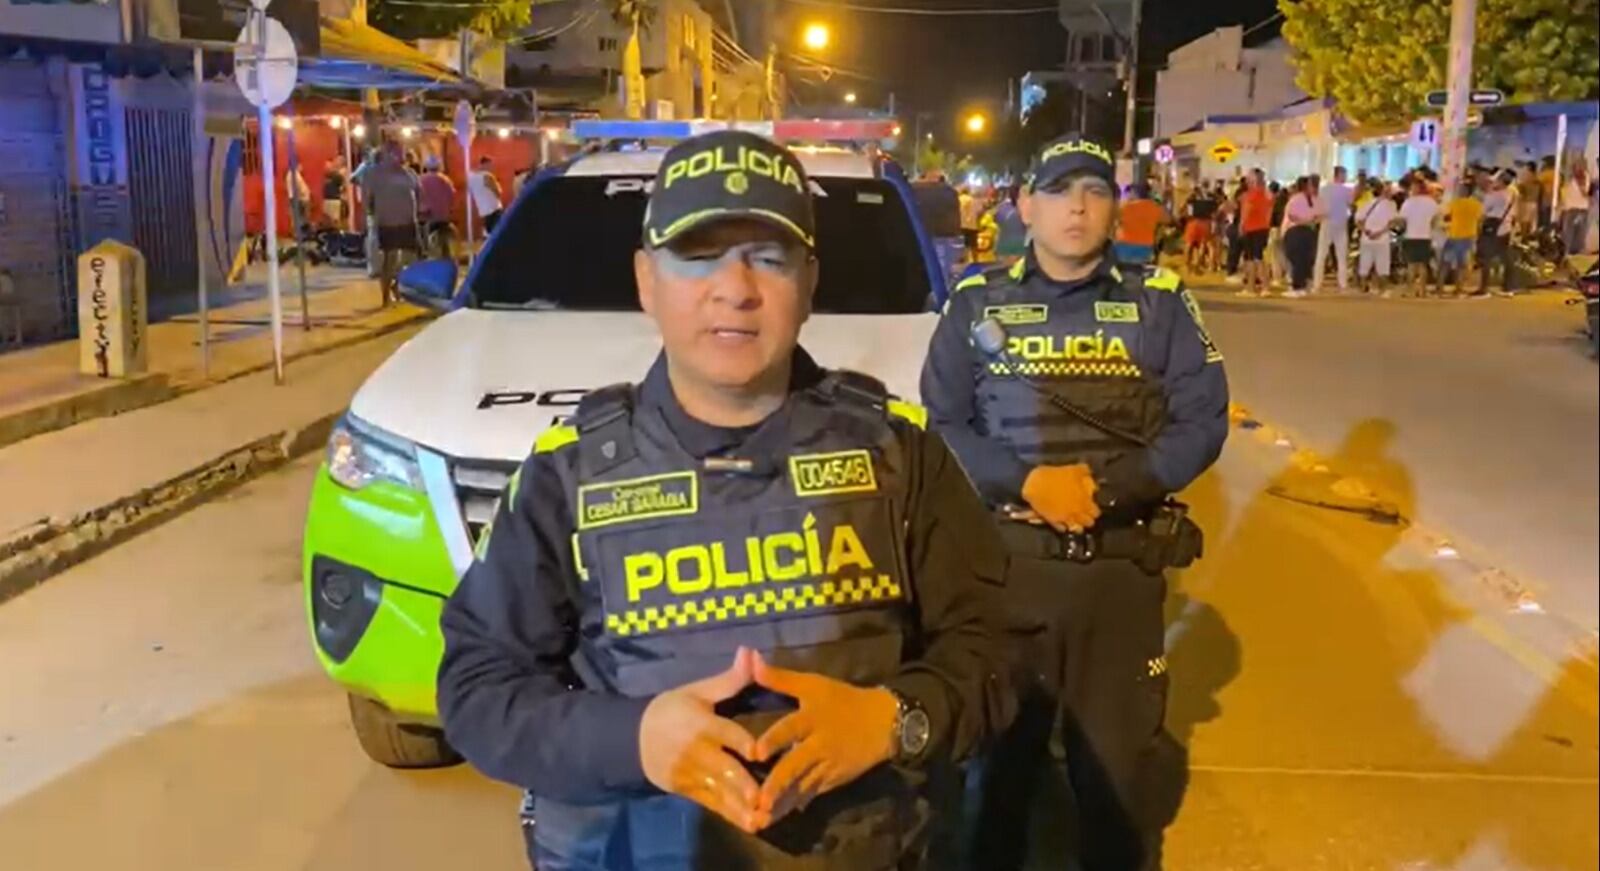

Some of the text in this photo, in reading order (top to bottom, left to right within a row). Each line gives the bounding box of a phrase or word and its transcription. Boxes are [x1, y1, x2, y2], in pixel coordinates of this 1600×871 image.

[664, 145, 803, 194] POLICÍA
[799, 458, 869, 489] 004546
[624, 512, 874, 602] POLICÍA
